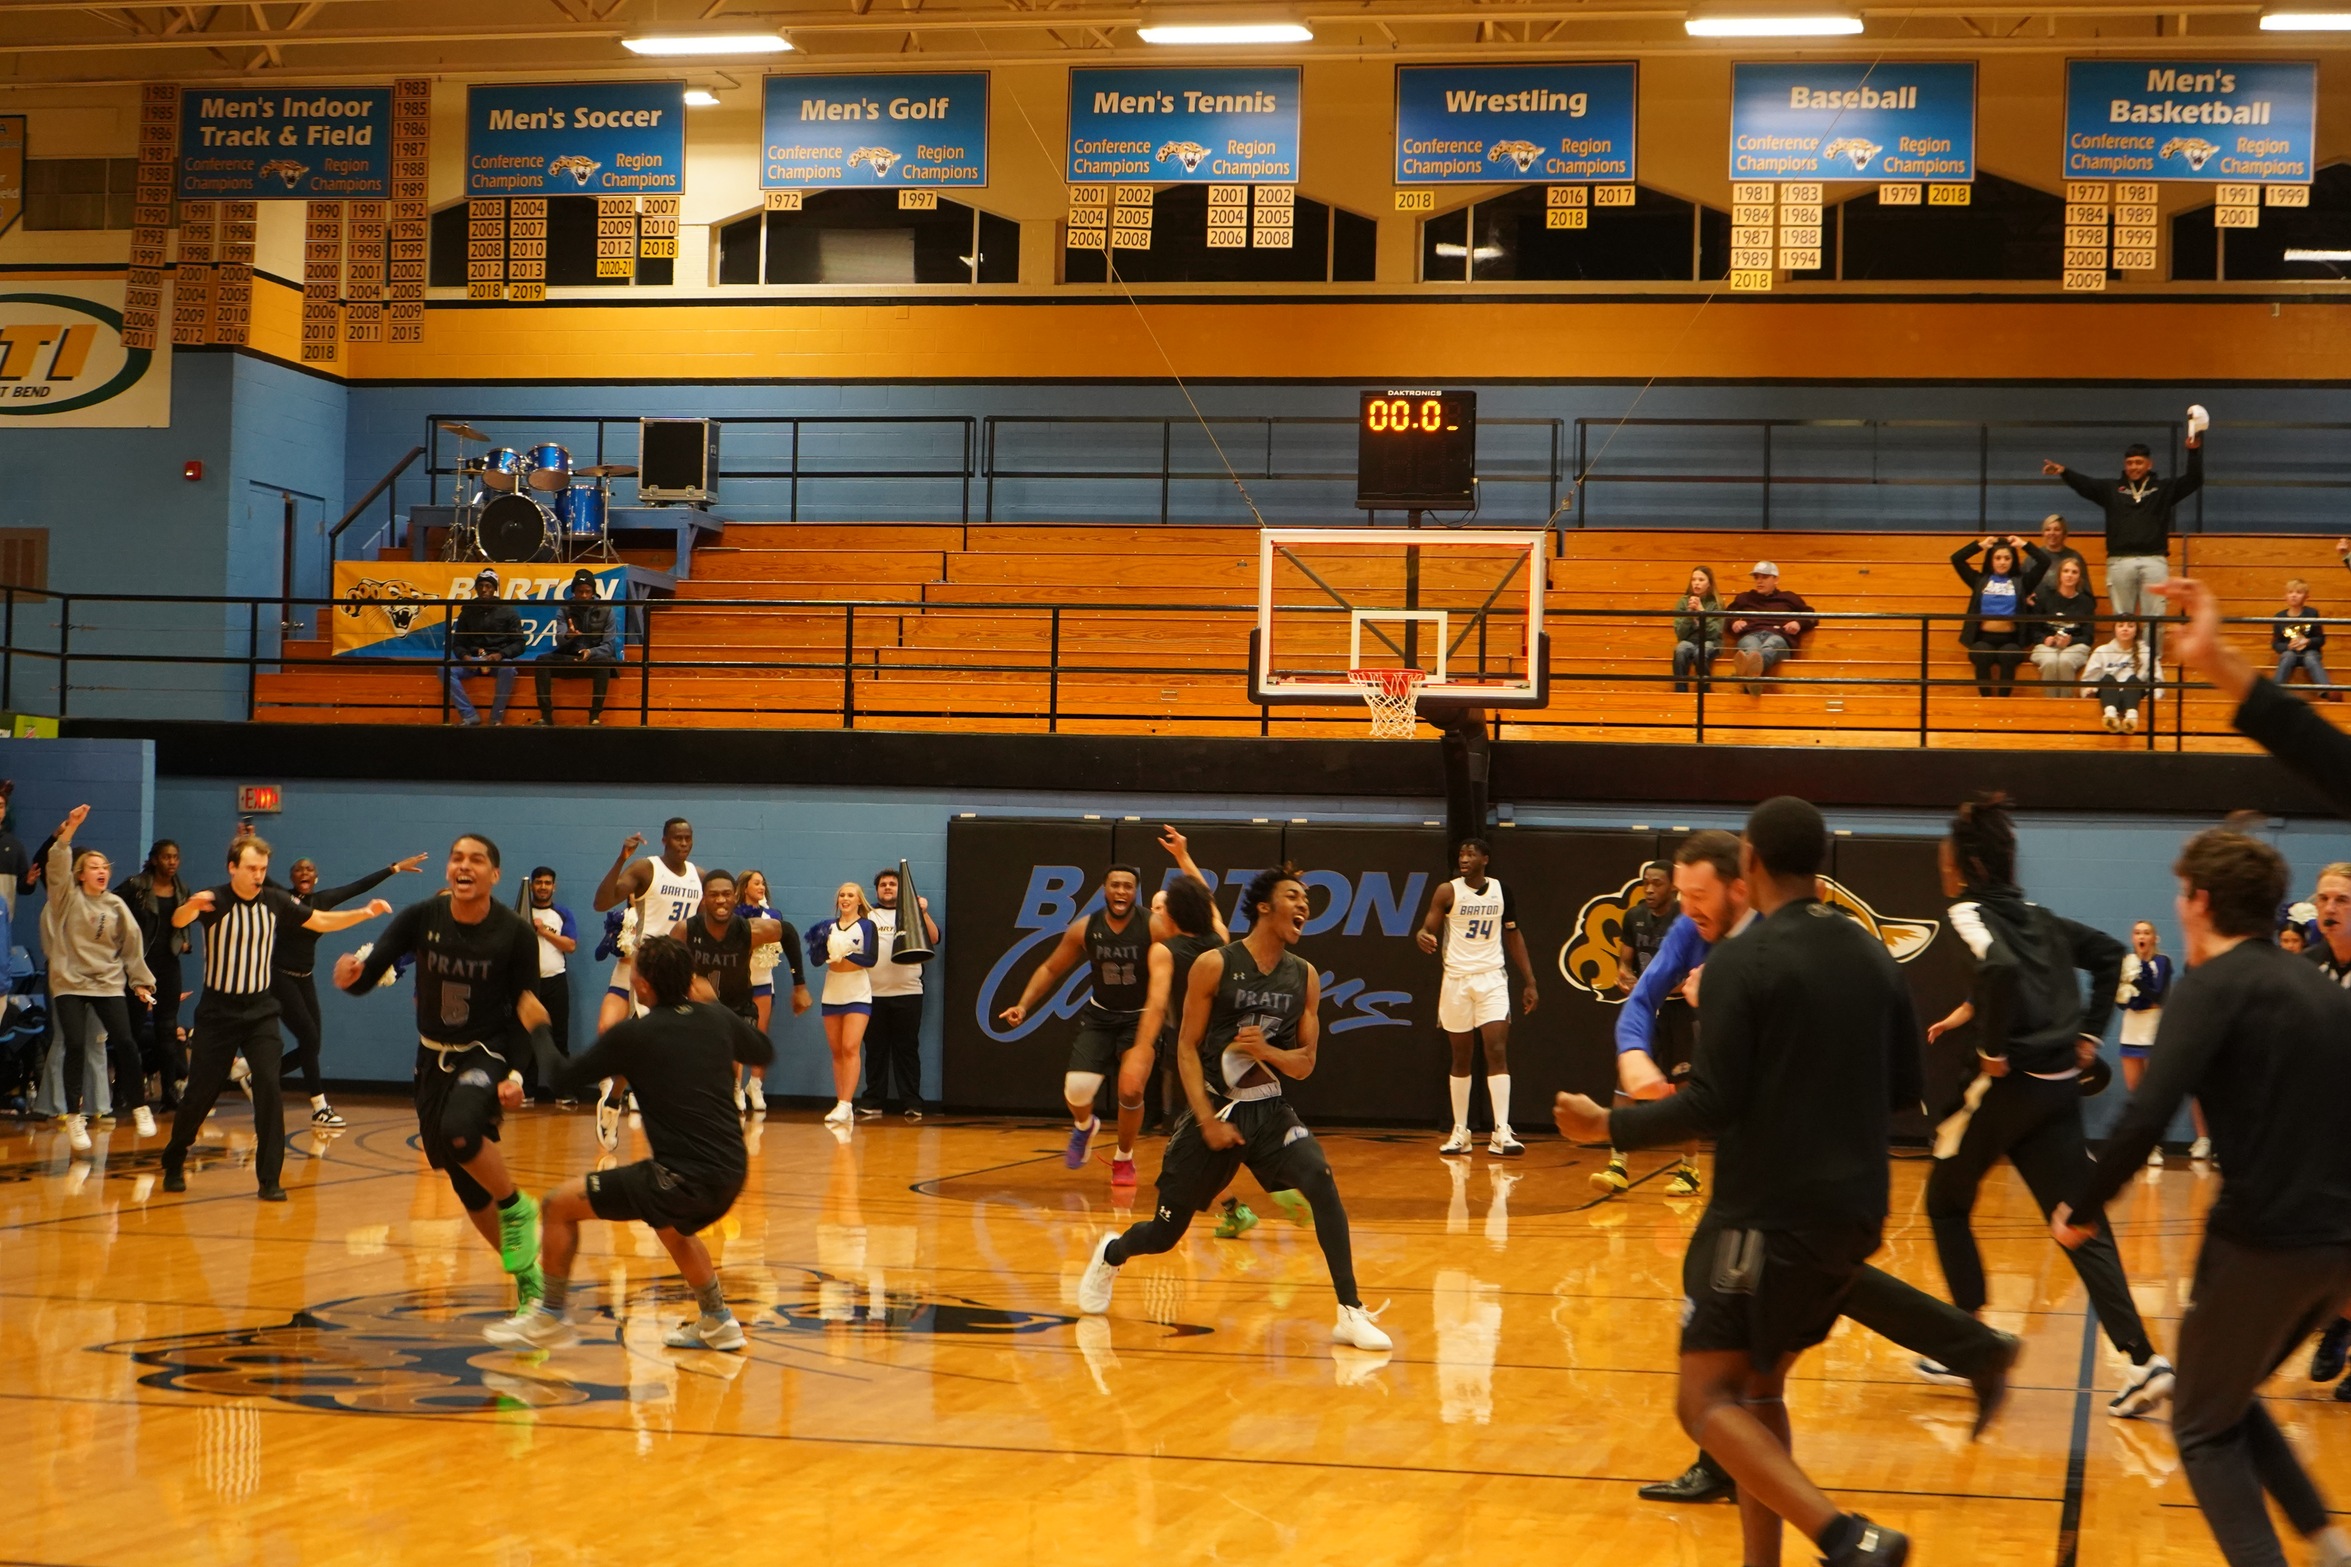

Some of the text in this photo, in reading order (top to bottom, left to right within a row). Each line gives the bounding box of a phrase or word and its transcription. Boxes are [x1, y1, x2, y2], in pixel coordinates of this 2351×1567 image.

[396, 81, 427, 95] 1983
[2147, 69, 2236, 93] Men's
[1093, 91, 1276, 113] Men's Tennis
[1446, 89, 1587, 117] Wrestling
[1790, 86, 1917, 109] Baseball
[201, 97, 373, 118] Men's Indoor
[396, 102, 426, 116] 1985
[801, 97, 949, 121] Men's Golf
[2110, 100, 2271, 125] Basketball
[489, 107, 662, 130] Men's Soccer
[200, 125, 372, 146] Track & Field
[396, 122, 426, 136] 1986
[1074, 139, 1150, 154] Conference
[1403, 138, 1483, 154] Conference
[1562, 138, 1611, 157] Region
[1737, 135, 1819, 151] Conference
[1899, 137, 1950, 155] Region
[2071, 133, 2154, 150] Conference
[2237, 137, 2289, 157] Region
[396, 143, 425, 156] 1987
[768, 145, 842, 160] Conference
[917, 145, 964, 163] Region
[1228, 139, 1276, 159] Region
[185, 157, 254, 171] Conference
[324, 158, 369, 175] Region
[472, 154, 544, 169] Conference
[616, 153, 662, 171] Region
[1074, 159, 1149, 176] Champions
[1403, 159, 1482, 177] Champions
[1546, 158, 1626, 177] Champions
[1737, 155, 1818, 174] Champions
[1884, 157, 1965, 177] Champions
[2071, 154, 2154, 173] Champions
[2220, 158, 2304, 178] Champions
[395, 162, 425, 176] 1988
[768, 164, 841, 182] Champions
[903, 164, 977, 183] Champions
[1213, 160, 1290, 178] Champions
[184, 176, 254, 193] Champions
[310, 177, 382, 194] Champions
[472, 175, 543, 191] Champions
[602, 173, 675, 190] Champions
[394, 183, 424, 196] 1989
[1074, 189, 1104, 202] 2001
[1118, 189, 1150, 202] 2002
[1212, 189, 1244, 202] 2001
[1258, 189, 1291, 203] 2002
[1598, 189, 1631, 203] 2017
[1738, 186, 1769, 200] 1981
[1785, 186, 1818, 200] 1983
[1883, 188, 1917, 202] 1979
[1932, 188, 1967, 202] 2018
[2070, 186, 2104, 200] 1977
[2120, 186, 2154, 200] 1981
[2221, 188, 2254, 202] 1991
[2270, 189, 2305, 204] 1999
[768, 194, 798, 208] 1972
[902, 193, 934, 207] 1997
[1398, 194, 1431, 208] 2018
[1551, 190, 1583, 204] 2016
[310, 204, 339, 218] 1990
[353, 204, 381, 218] 1991
[395, 203, 423, 216] 1992
[472, 202, 502, 215] 2003
[513, 201, 544, 215] 2004
[601, 200, 632, 214] 2002
[645, 199, 676, 213] 2007
[1071, 210, 1104, 224] 2004
[1116, 210, 1149, 225] 2005
[1211, 210, 1244, 224] 2004
[1256, 210, 1290, 224] 2005
[1551, 212, 1583, 226] 2018
[1736, 208, 1769, 222] 1984
[1784, 208, 1817, 222] 1986
[2069, 208, 2104, 222] 1984
[2116, 208, 2153, 222] 1989
[2220, 210, 2254, 224] 2001
[309, 224, 339, 238] 1993
[352, 224, 381, 238] 1995
[394, 223, 423, 237] 1996
[471, 222, 501, 236] 2005
[513, 222, 544, 236] 2007
[600, 220, 632, 234] 2009
[644, 220, 675, 234] 2010
[1070, 231, 1102, 246] 2006
[1114, 232, 1148, 246] 2008
[1210, 231, 1243, 245] 2006
[1256, 231, 1289, 245] 2008
[1736, 230, 1769, 245] 1987
[1784, 230, 1817, 244] 1988
[2069, 229, 2103, 244] 1998
[2117, 230, 2152, 245] 1999
[308, 245, 338, 258] 1997
[351, 244, 381, 258] 1998
[394, 244, 423, 258] 1999
[471, 243, 501, 257] 2008
[513, 243, 543, 257] 2010
[600, 241, 631, 255] 2012
[644, 241, 674, 255] 2018
[1735, 252, 1768, 266] 1989
[1783, 252, 1817, 266] 1994
[2067, 251, 2103, 266] 2000
[2116, 252, 2152, 266] 2003
[307, 265, 338, 278] 2000
[351, 265, 380, 278] 2001
[393, 264, 422, 278] 2002
[471, 263, 500, 277] 2012
[512, 263, 542, 277] 2013
[600, 261, 632, 275] 2020-21
[1734, 274, 1768, 288] 2018
[2067, 273, 2102, 288] 2009
[306, 285, 337, 299] 2003
[349, 285, 380, 299] 2004
[393, 284, 422, 298] 2005
[470, 284, 500, 297] 2018
[513, 285, 541, 299] 2019
[305, 305, 336, 318] 2006
[348, 305, 379, 319] 2008
[392, 305, 421, 318] 2009
[305, 325, 335, 339] 2010
[349, 326, 378, 339] 2011
[392, 326, 420, 340] 2015
[304, 346, 334, 359] 2018
[12, 386, 50, 397] BEND
[660, 884, 699, 899] BARTON
[668, 902, 691, 921] 31
[1460, 905, 1499, 915] BARTON
[1465, 920, 1493, 939] 34
[694, 950, 739, 967] PRATT
[1096, 944, 1138, 960] PRATT
[428, 949, 492, 980] PRATT
[441, 980, 471, 1025] 5
[1234, 988, 1293, 1013] PRATT
